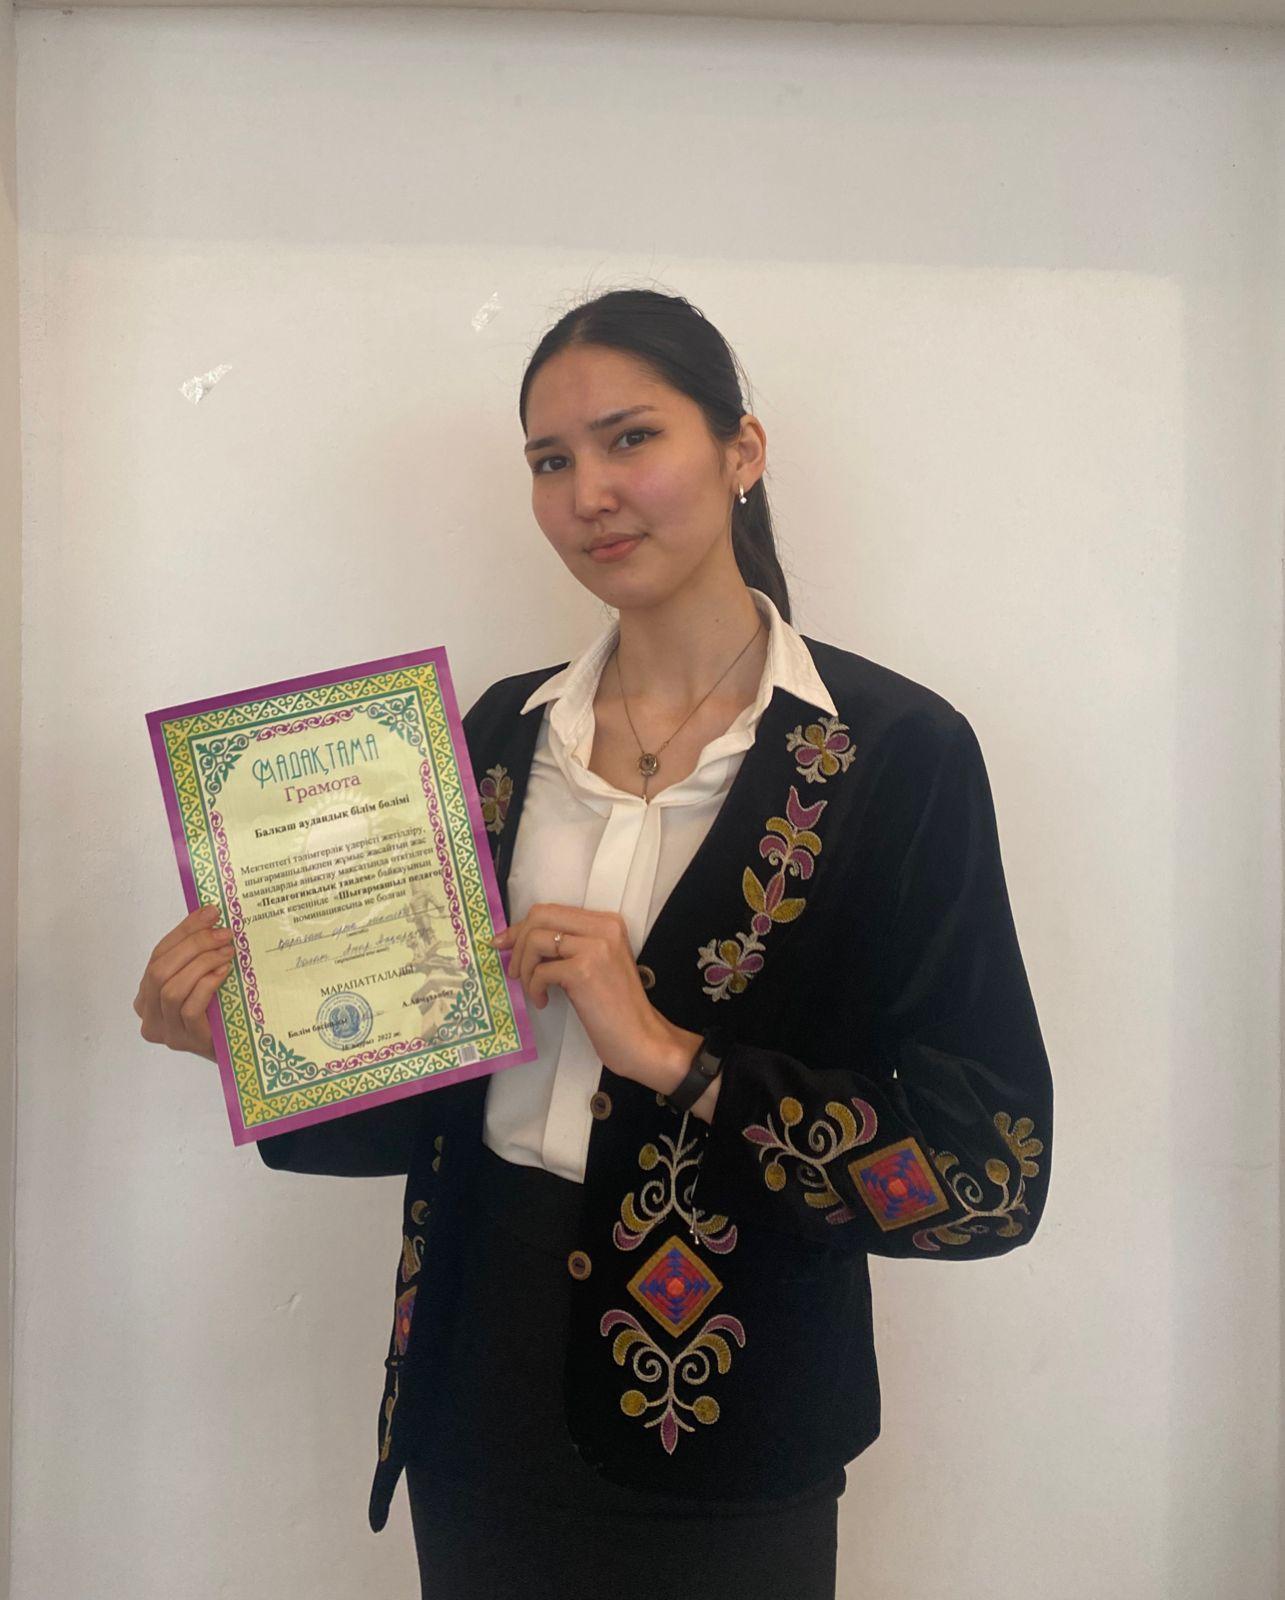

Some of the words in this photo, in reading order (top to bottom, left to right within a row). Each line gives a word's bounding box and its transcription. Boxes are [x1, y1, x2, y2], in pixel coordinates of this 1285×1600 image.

[250, 733, 381, 792] МАДАҚТАМА
[284, 771, 362, 806] Грамота
[350, 802, 376, 816] білім
[320, 965, 414, 997] МАРАПАТТАЛАДЫ
